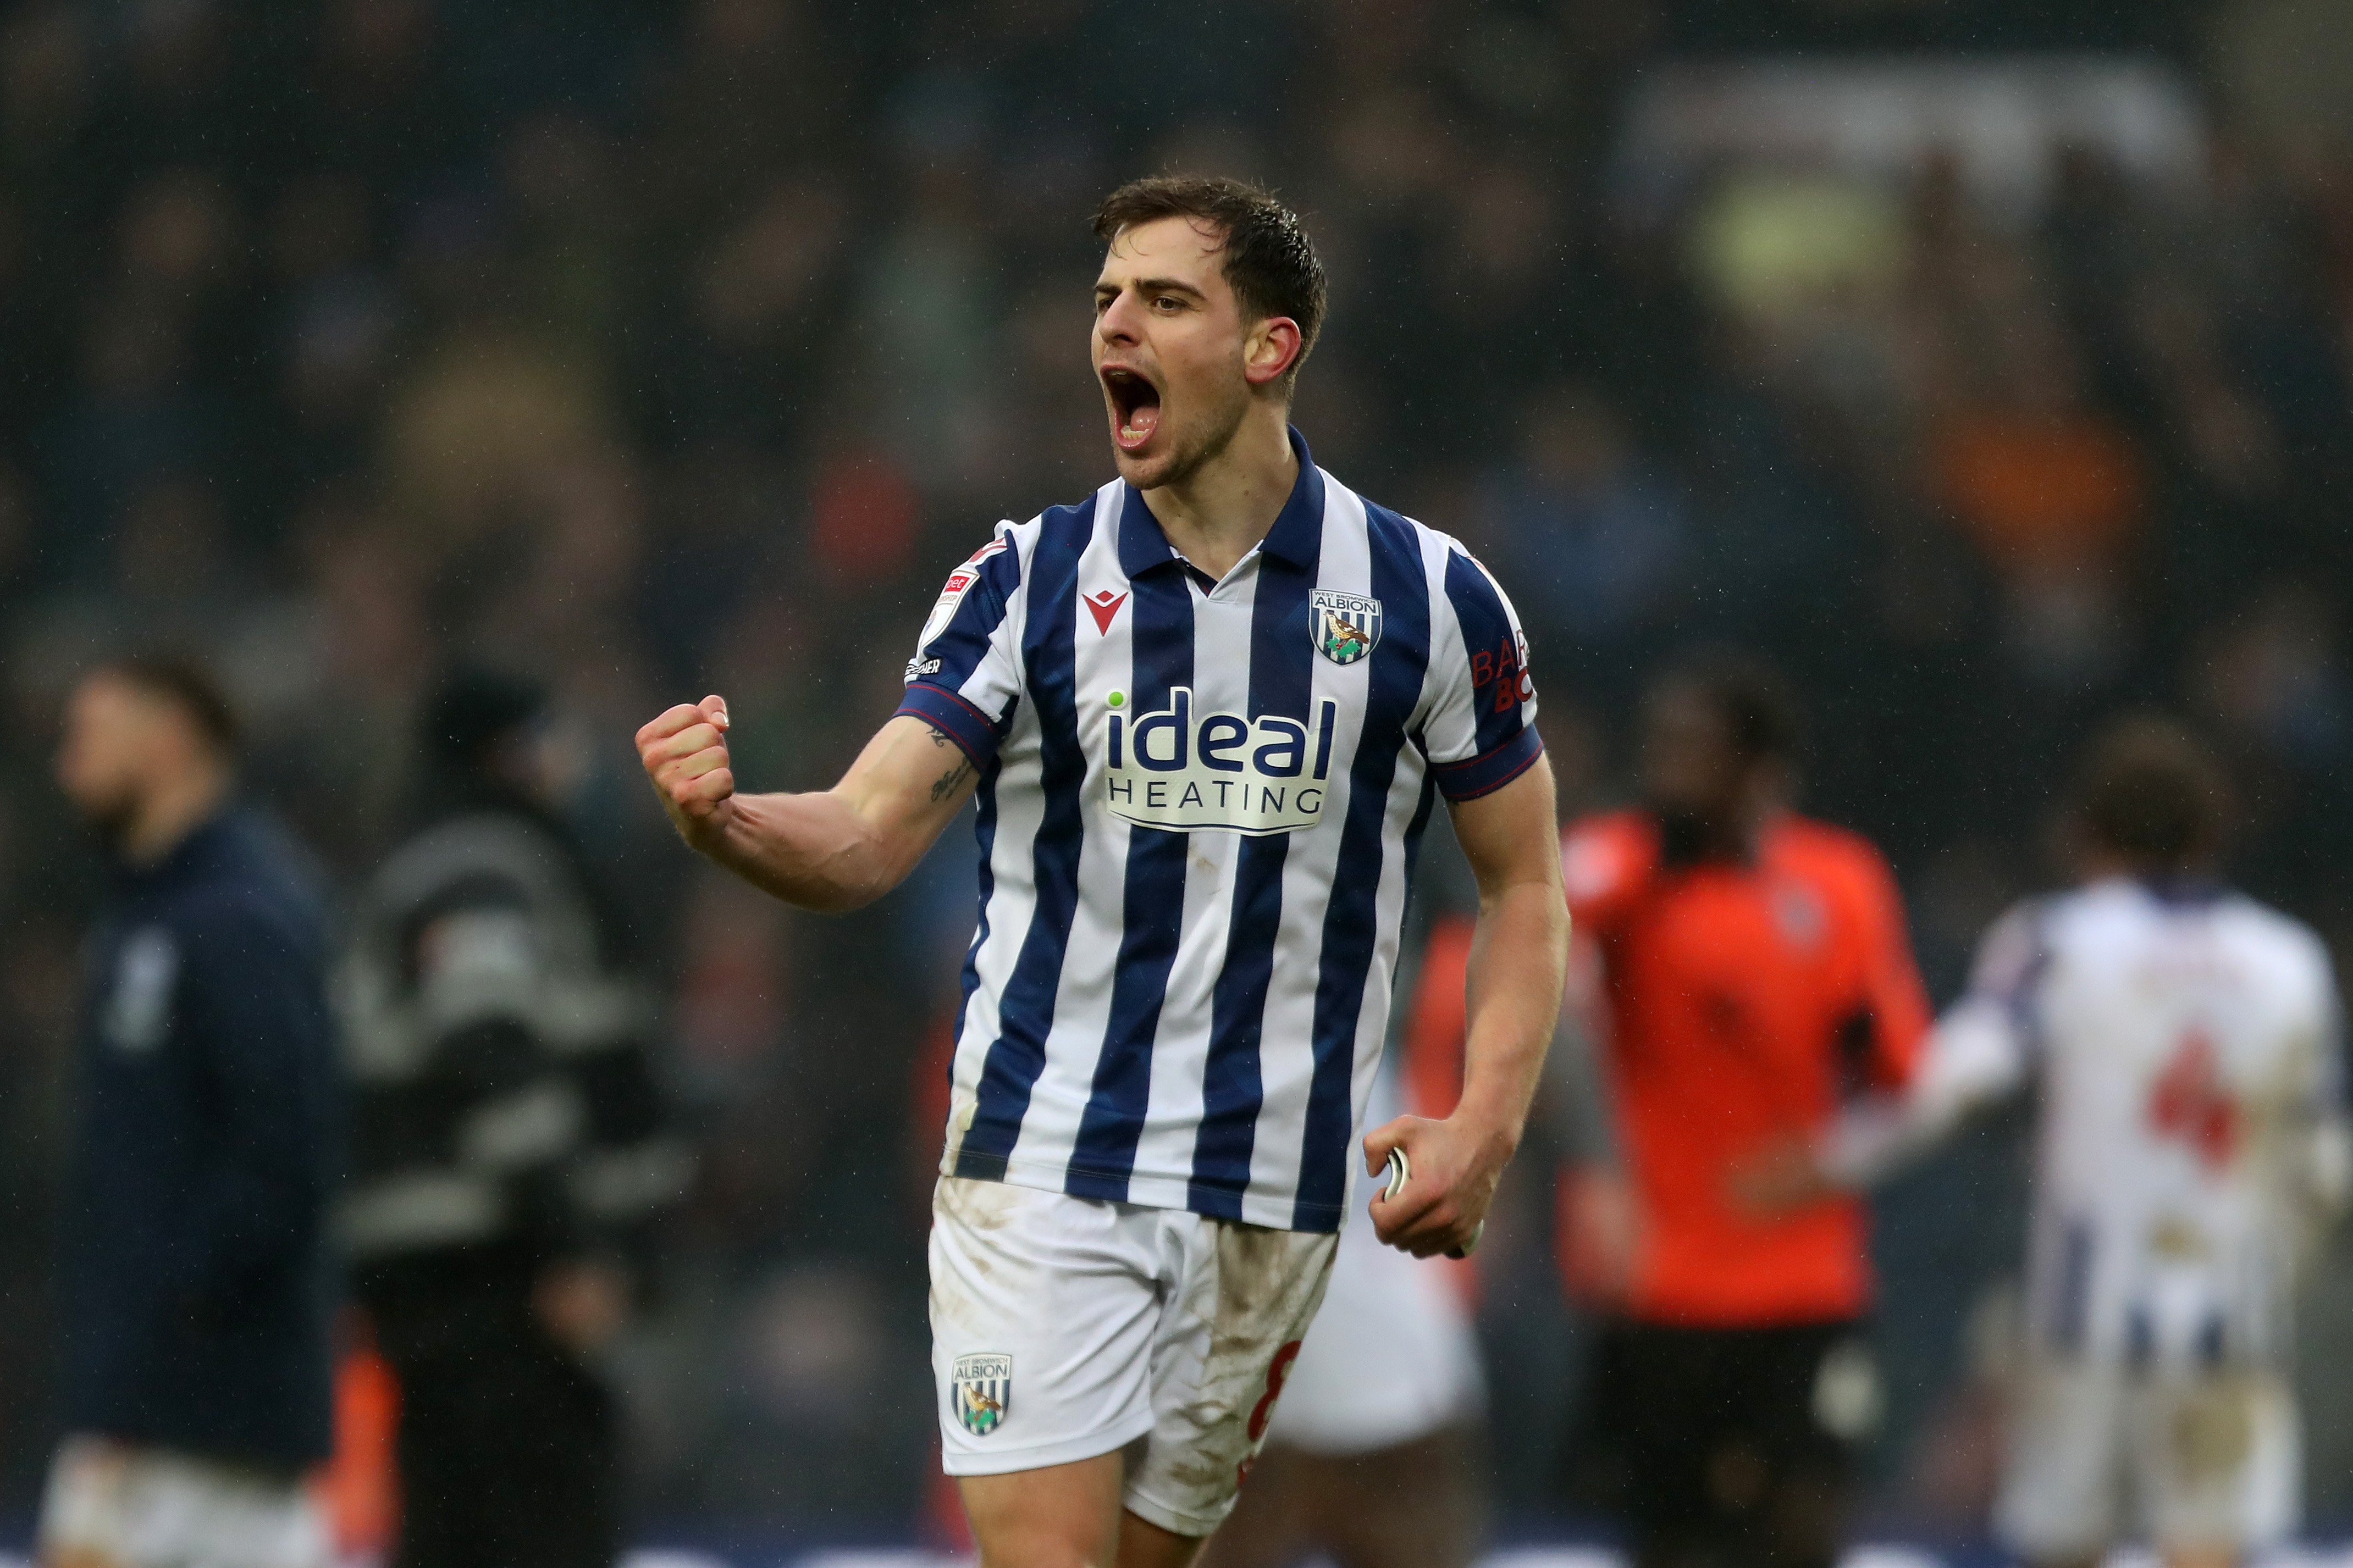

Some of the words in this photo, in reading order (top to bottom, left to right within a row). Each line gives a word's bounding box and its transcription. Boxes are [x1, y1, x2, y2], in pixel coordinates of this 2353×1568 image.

[1314, 596, 1377, 613] ALBION
[1335, 594, 1376, 604] BROMWICH
[1107, 690, 1336, 780] ideal
[1108, 777, 1323, 815] HEATING
[954, 1364, 1007, 1381] ALBION
